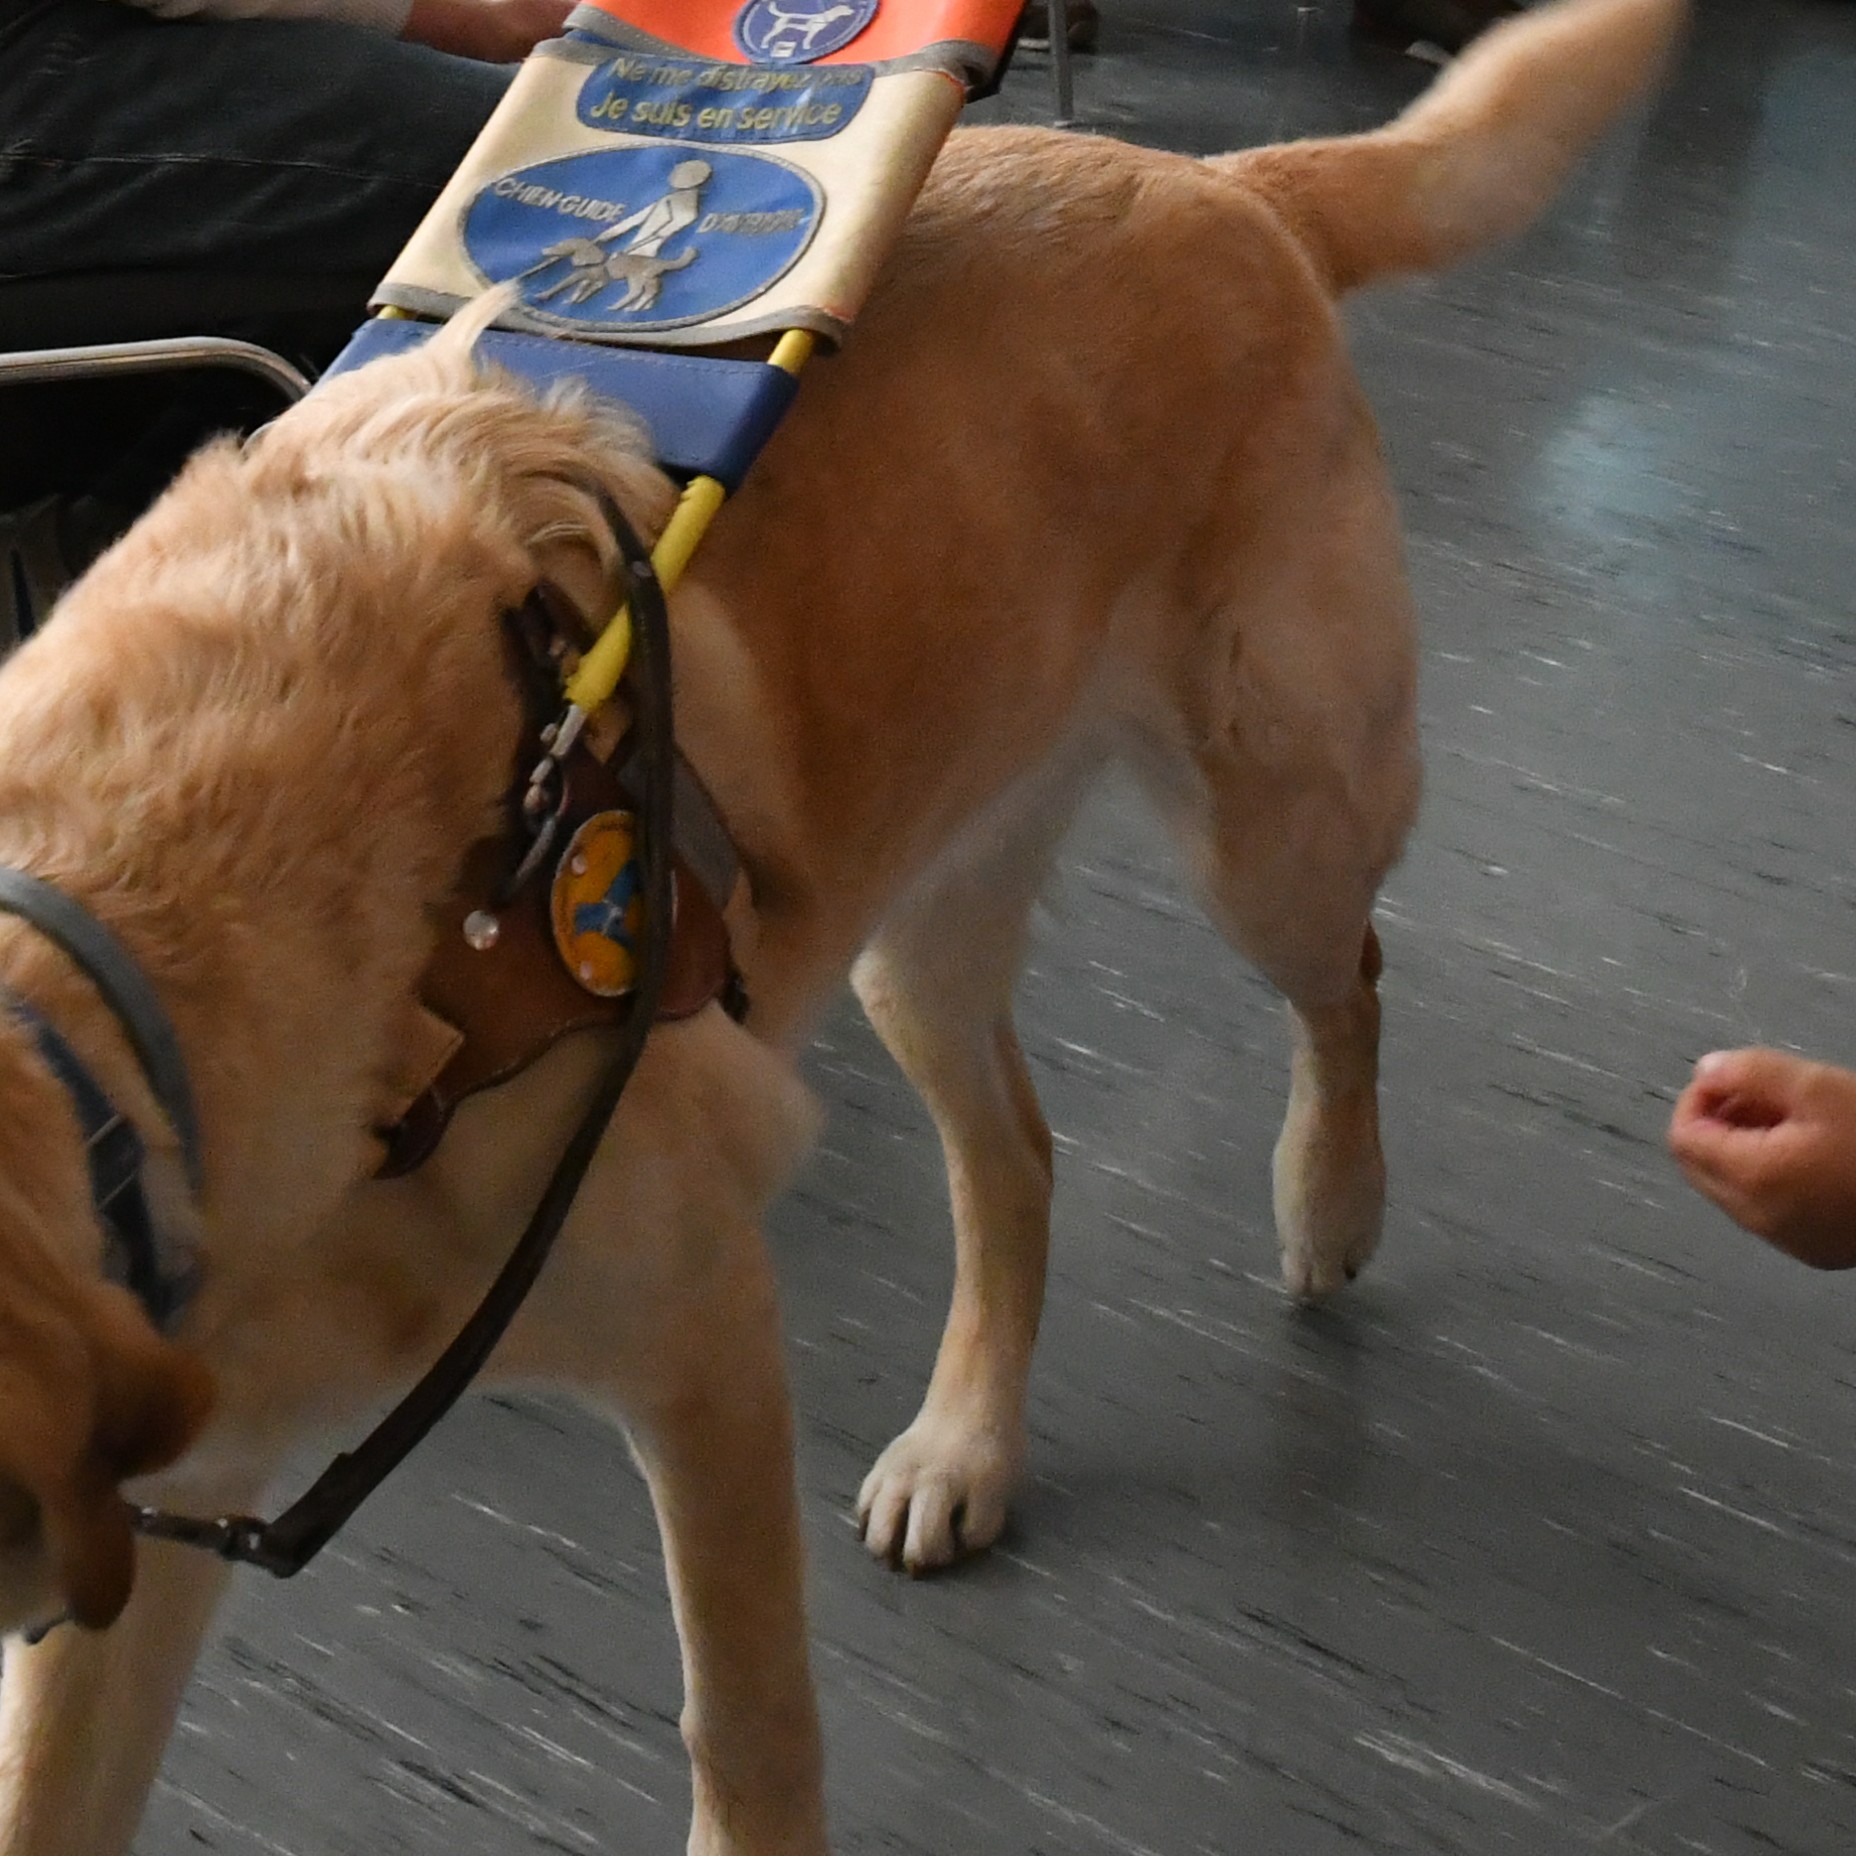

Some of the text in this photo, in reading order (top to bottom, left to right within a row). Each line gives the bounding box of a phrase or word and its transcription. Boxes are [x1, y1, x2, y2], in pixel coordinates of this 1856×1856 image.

[610, 57, 644, 81] Ne
[649, 67, 692, 86] me
[590, 91, 843, 130] Je suis en service
